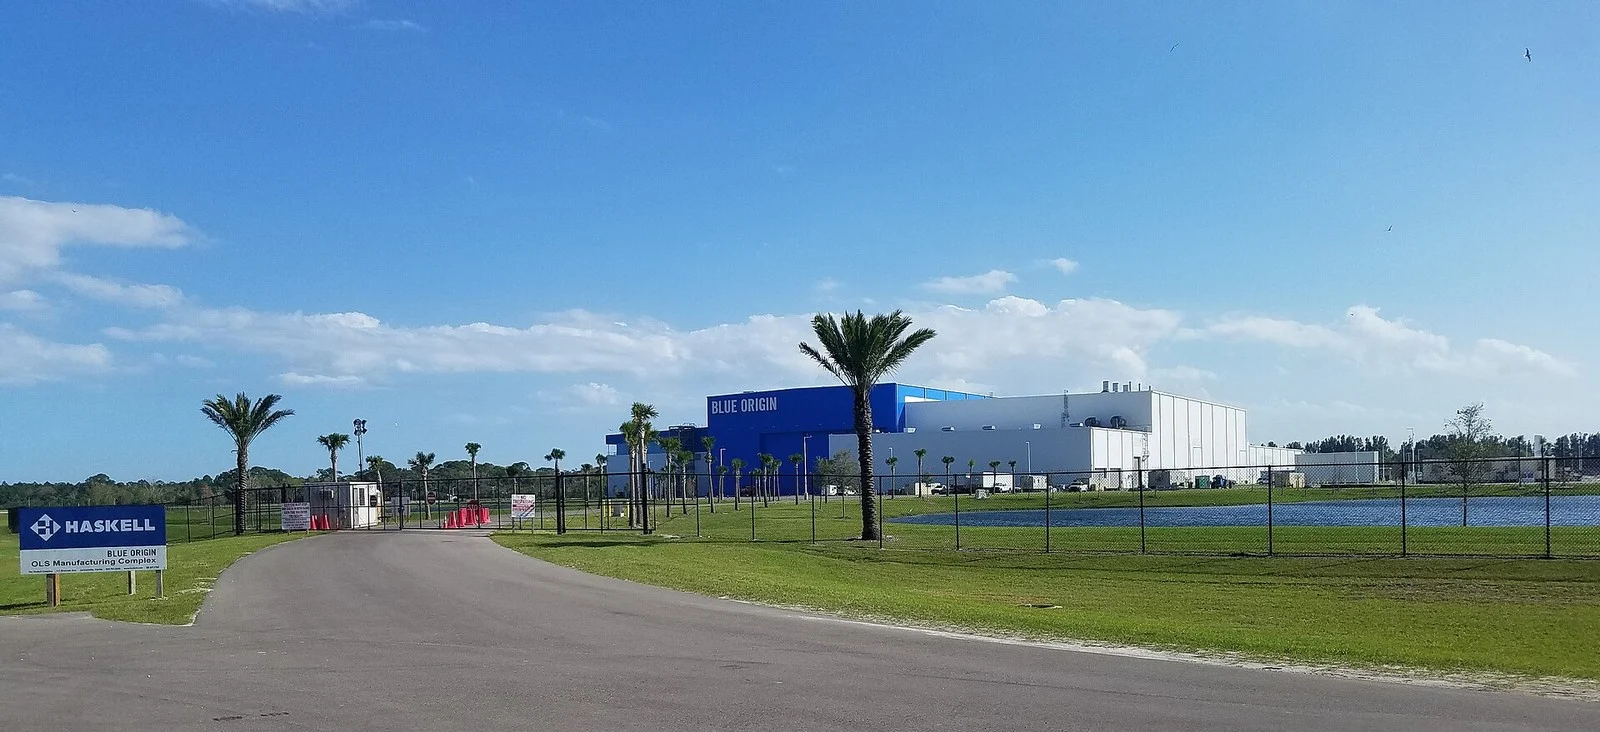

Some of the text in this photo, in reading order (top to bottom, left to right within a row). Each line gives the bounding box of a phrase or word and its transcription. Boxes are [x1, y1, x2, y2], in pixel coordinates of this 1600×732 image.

[711, 397, 777, 414] BLUE ORIGIN
[65, 518, 156, 533] HASKELL
[107, 548, 157, 558] BLUE ORIGIN
[52, 558, 116, 567] Manufacturing
[118, 557, 157, 565] Complex
